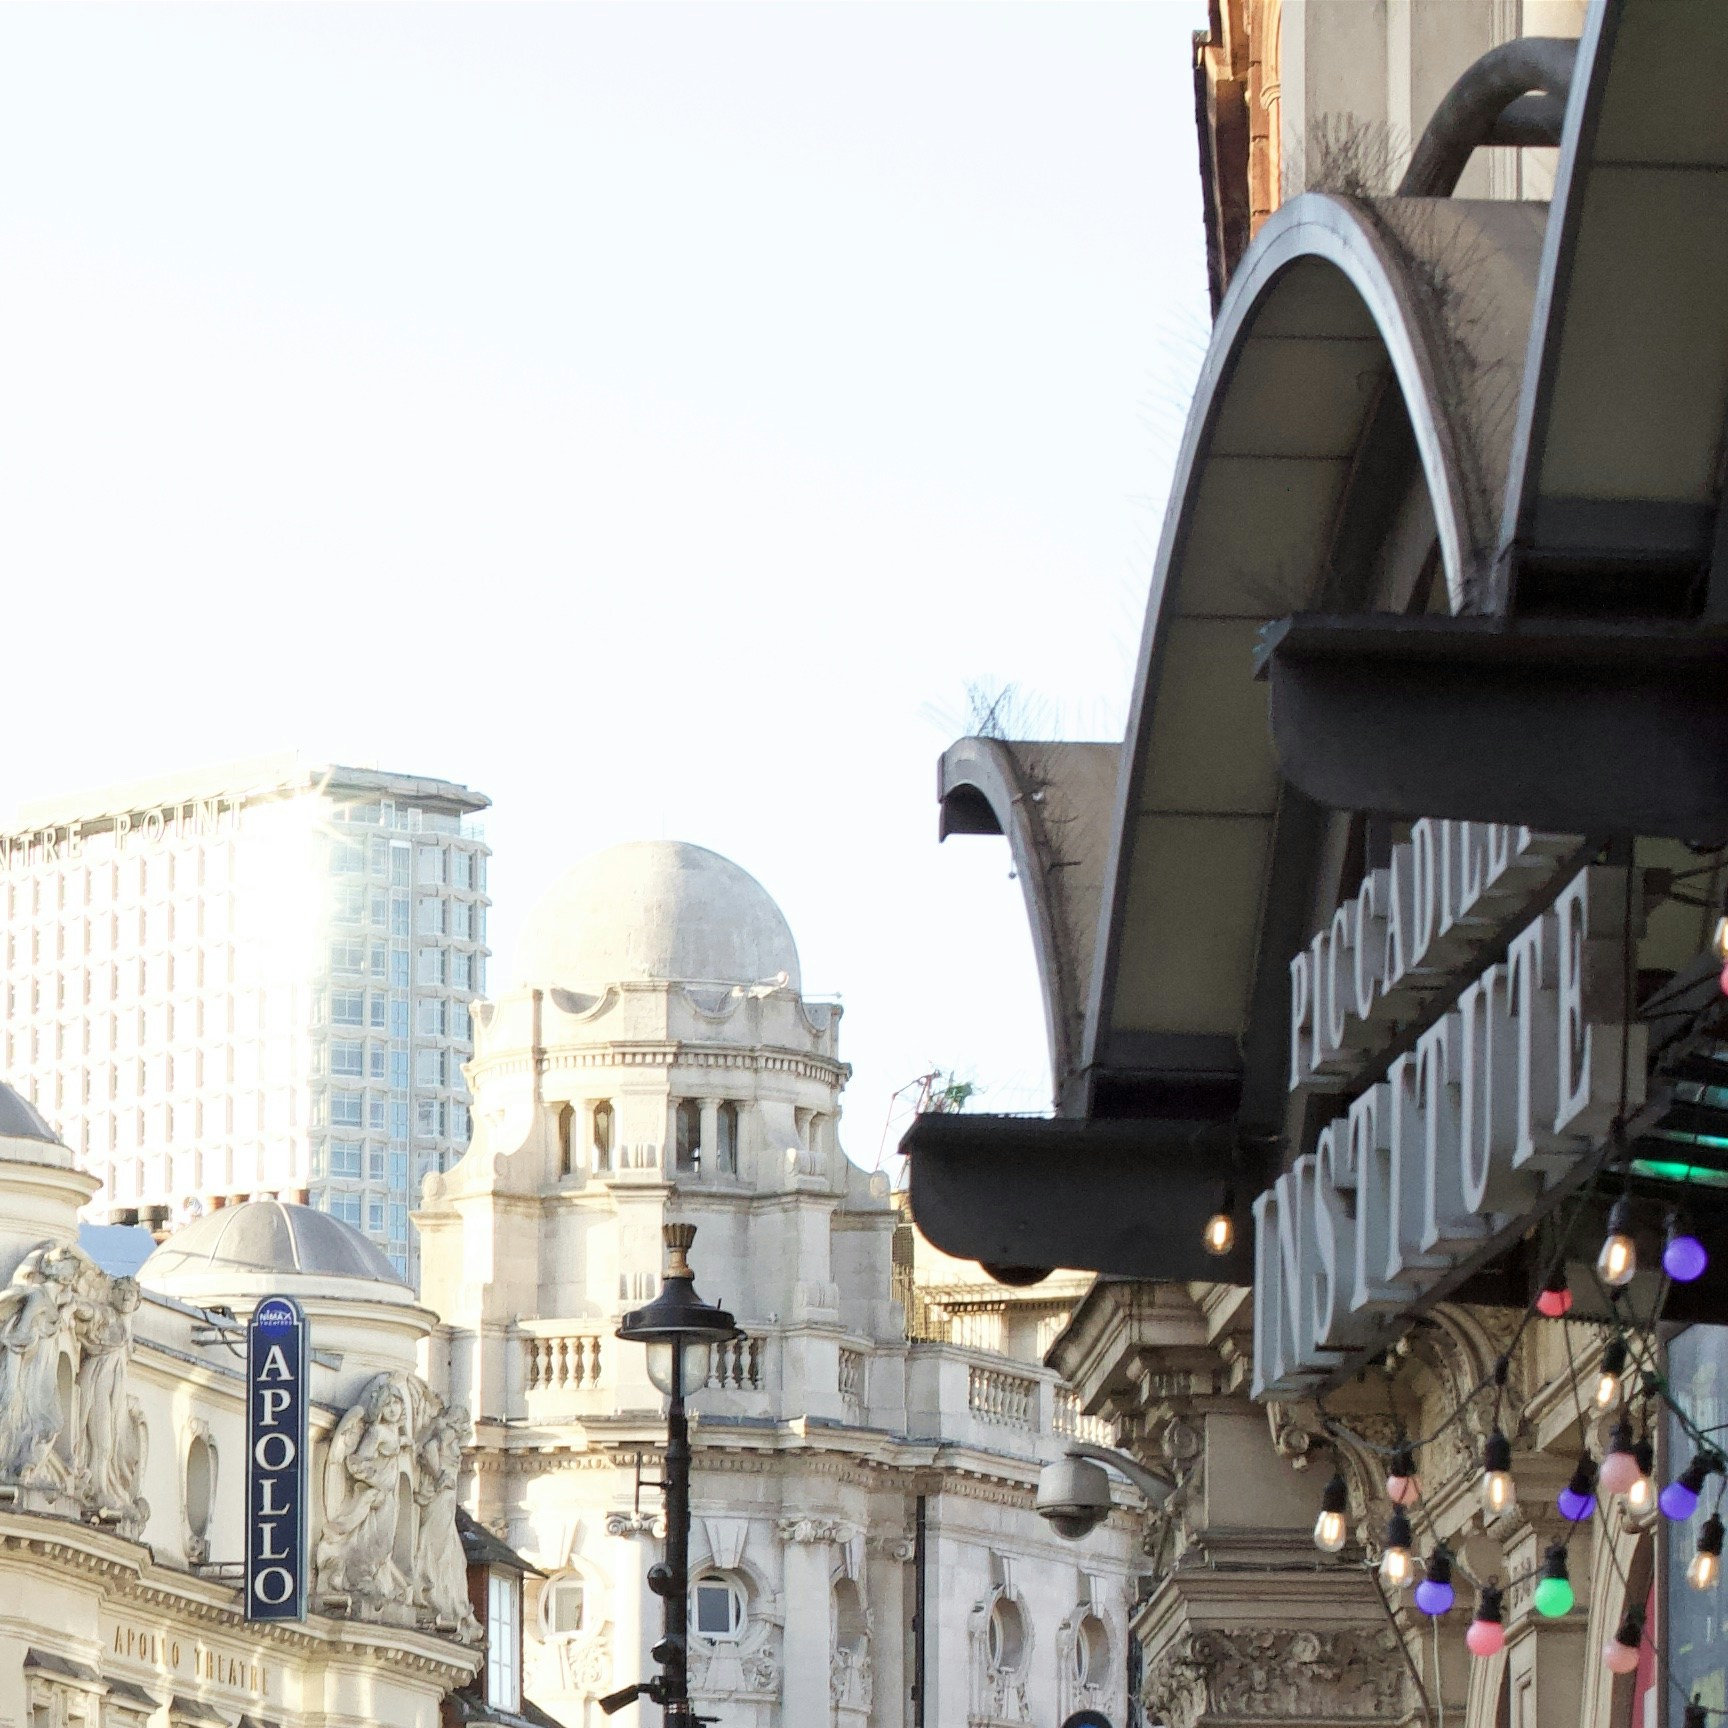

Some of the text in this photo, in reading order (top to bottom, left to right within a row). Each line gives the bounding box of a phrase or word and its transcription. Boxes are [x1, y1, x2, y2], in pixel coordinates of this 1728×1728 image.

[1250, 865, 1592, 1401] INSTITUTE
[254, 1344, 295, 1604] APOLLO
[114, 1625, 269, 1696] APOLLO THEATRE
